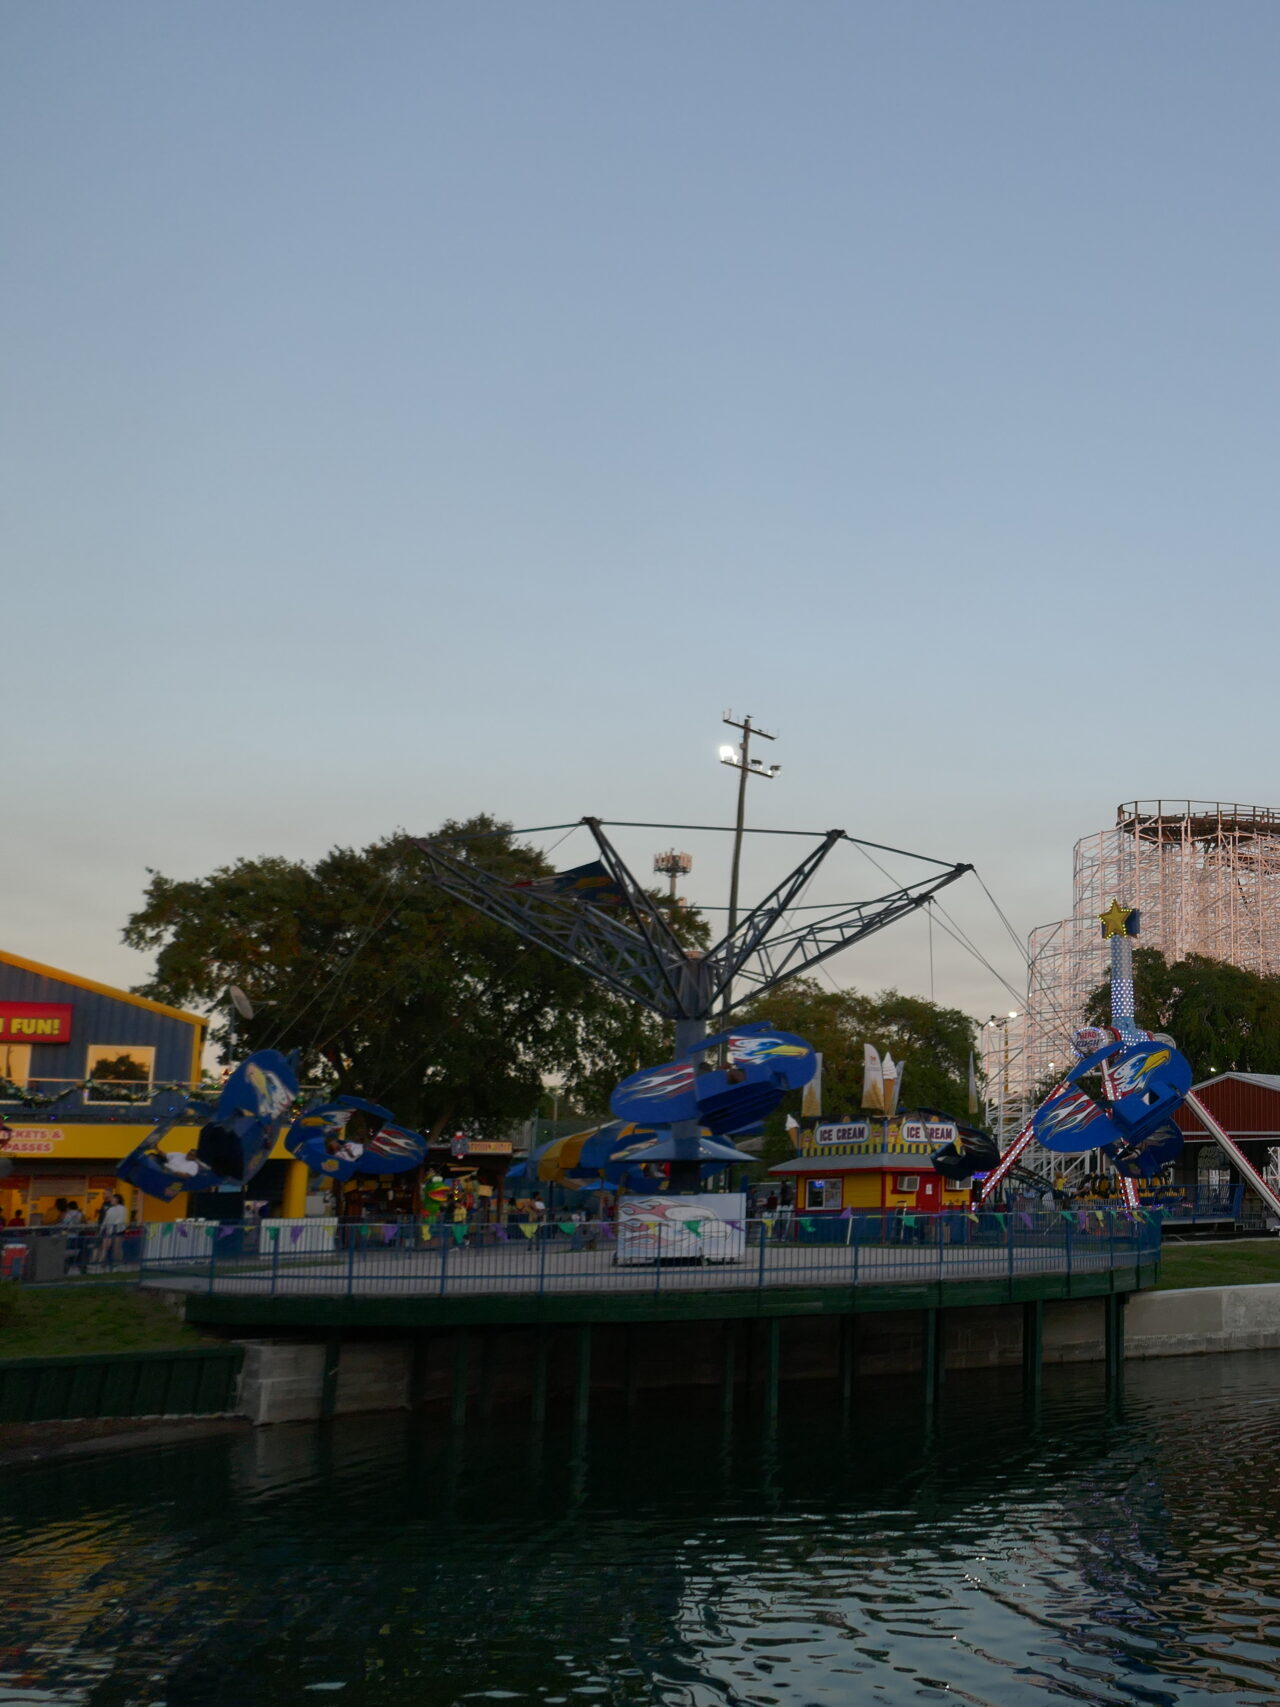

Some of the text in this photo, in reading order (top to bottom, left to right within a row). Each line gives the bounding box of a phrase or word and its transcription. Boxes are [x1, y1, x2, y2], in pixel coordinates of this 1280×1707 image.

[10, 1017, 60, 1035] FUN!
[819, 1127, 865, 1142] ICE CREAM
[906, 1126, 921, 1139] ICE
[2, 1143, 51, 1152] PASSES
